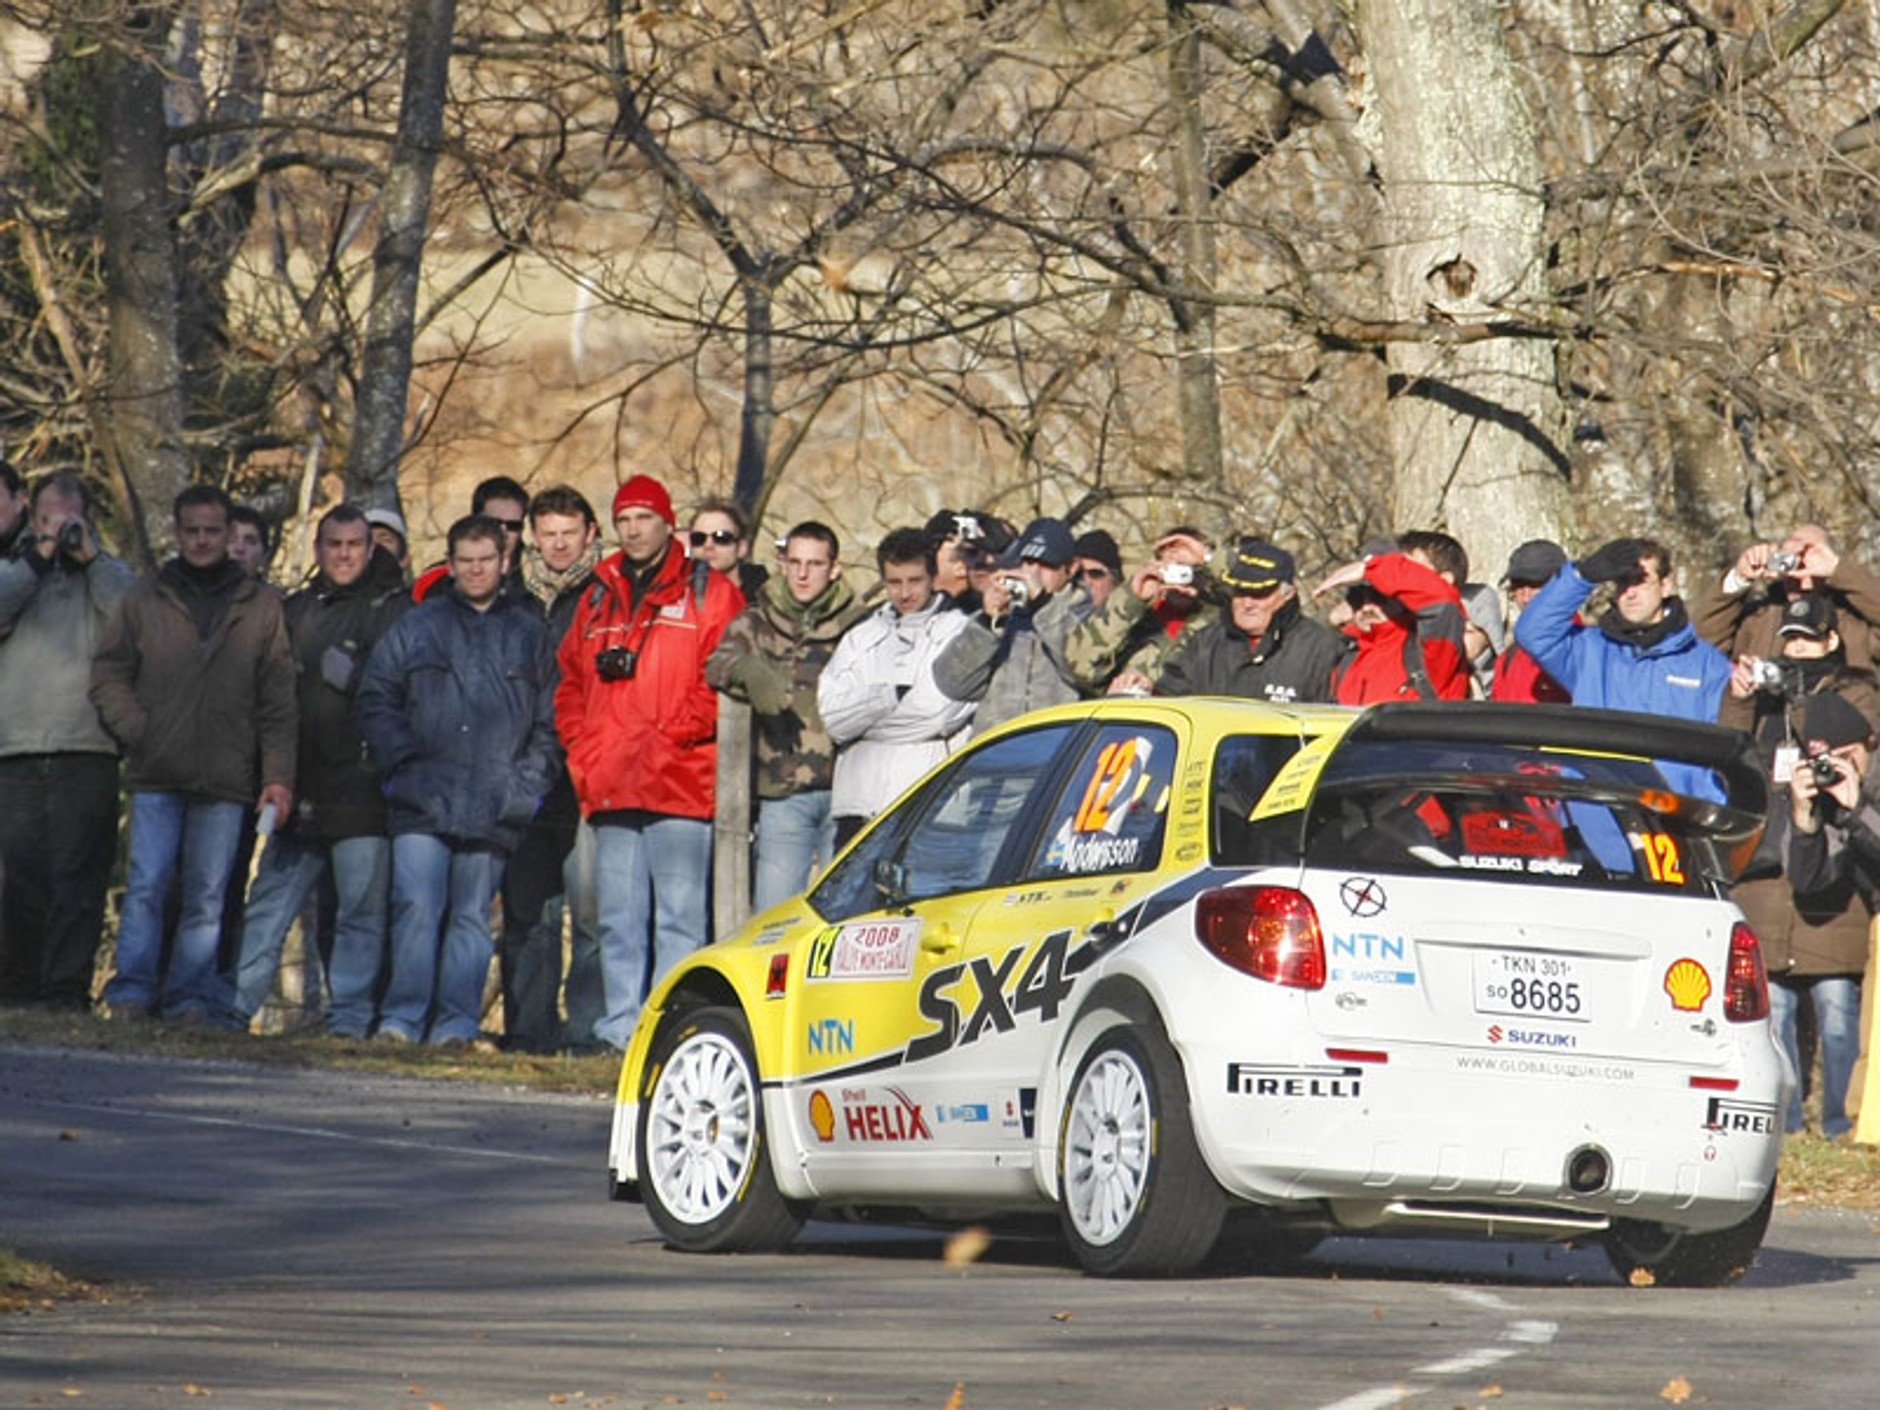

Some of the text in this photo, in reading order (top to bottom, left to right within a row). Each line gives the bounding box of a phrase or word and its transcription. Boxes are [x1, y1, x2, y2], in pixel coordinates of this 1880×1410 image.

[1072, 737, 1140, 833] 12
[1458, 856, 1583, 876] SUZUKI SPORT
[1640, 831, 1686, 885] 12
[811, 926, 842, 977] 12
[855, 926, 902, 948] 2008
[1333, 933, 1404, 960] NTN
[1502, 955, 1567, 977] TKN 301
[904, 929, 1077, 1063] SX4
[1486, 977, 1581, 1014] SO 8685
[808, 1019, 853, 1055] NTN
[1508, 1029, 1577, 1048] SUZUKI
[841, 1088, 866, 1102] Shell
[1227, 1063, 1363, 1097] PIRELLI
[843, 1104, 931, 1141] HELIX
